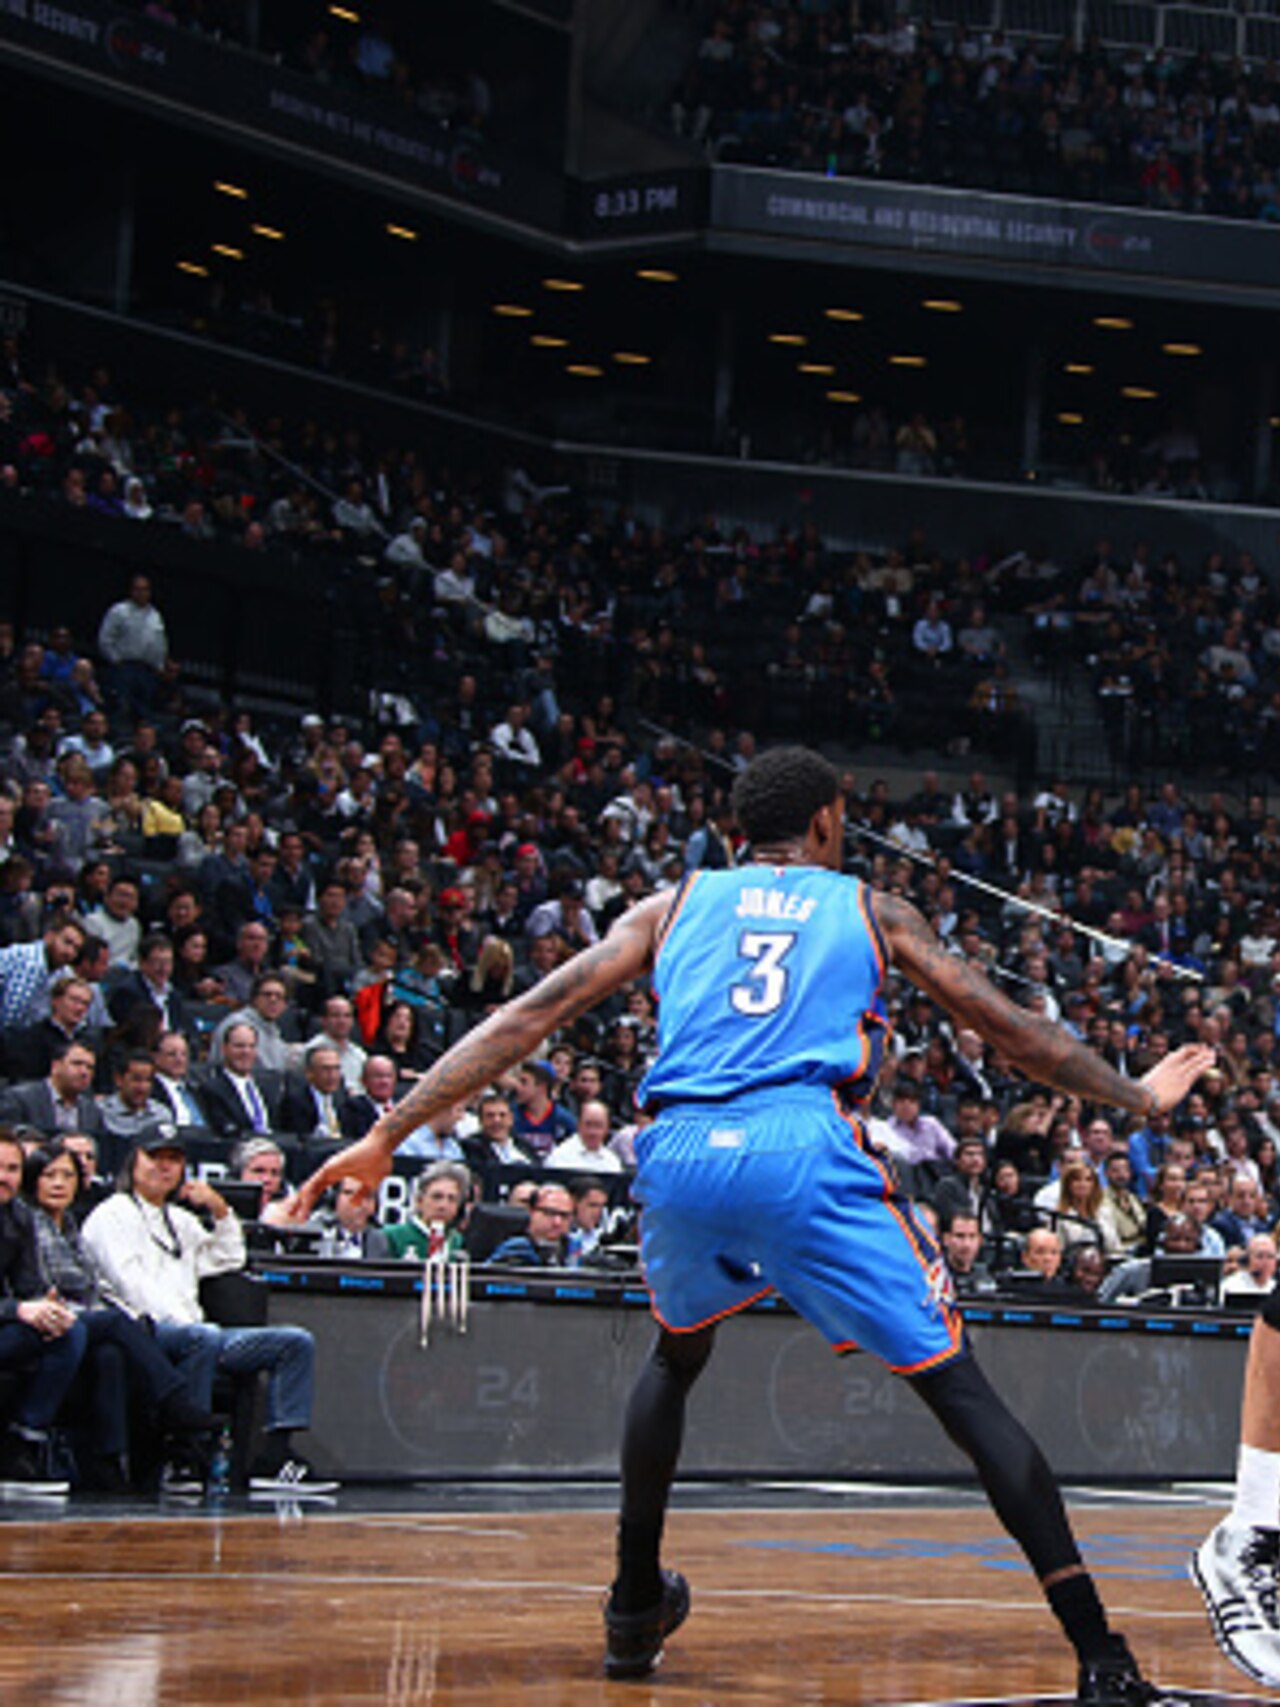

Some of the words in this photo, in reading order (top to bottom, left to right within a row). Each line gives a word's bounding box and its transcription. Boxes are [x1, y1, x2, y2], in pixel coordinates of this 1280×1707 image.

[594, 188, 639, 217] 8:33
[644, 184, 677, 212] PM
[767, 194, 867, 225] COMMERCIAL
[874, 206, 904, 228] AND
[1007, 219, 1076, 246] SECURITY
[737, 888, 816, 921] JONES
[730, 930, 796, 1017] 3
[475, 1366, 541, 1410] 24
[844, 1377, 896, 1415] 24
